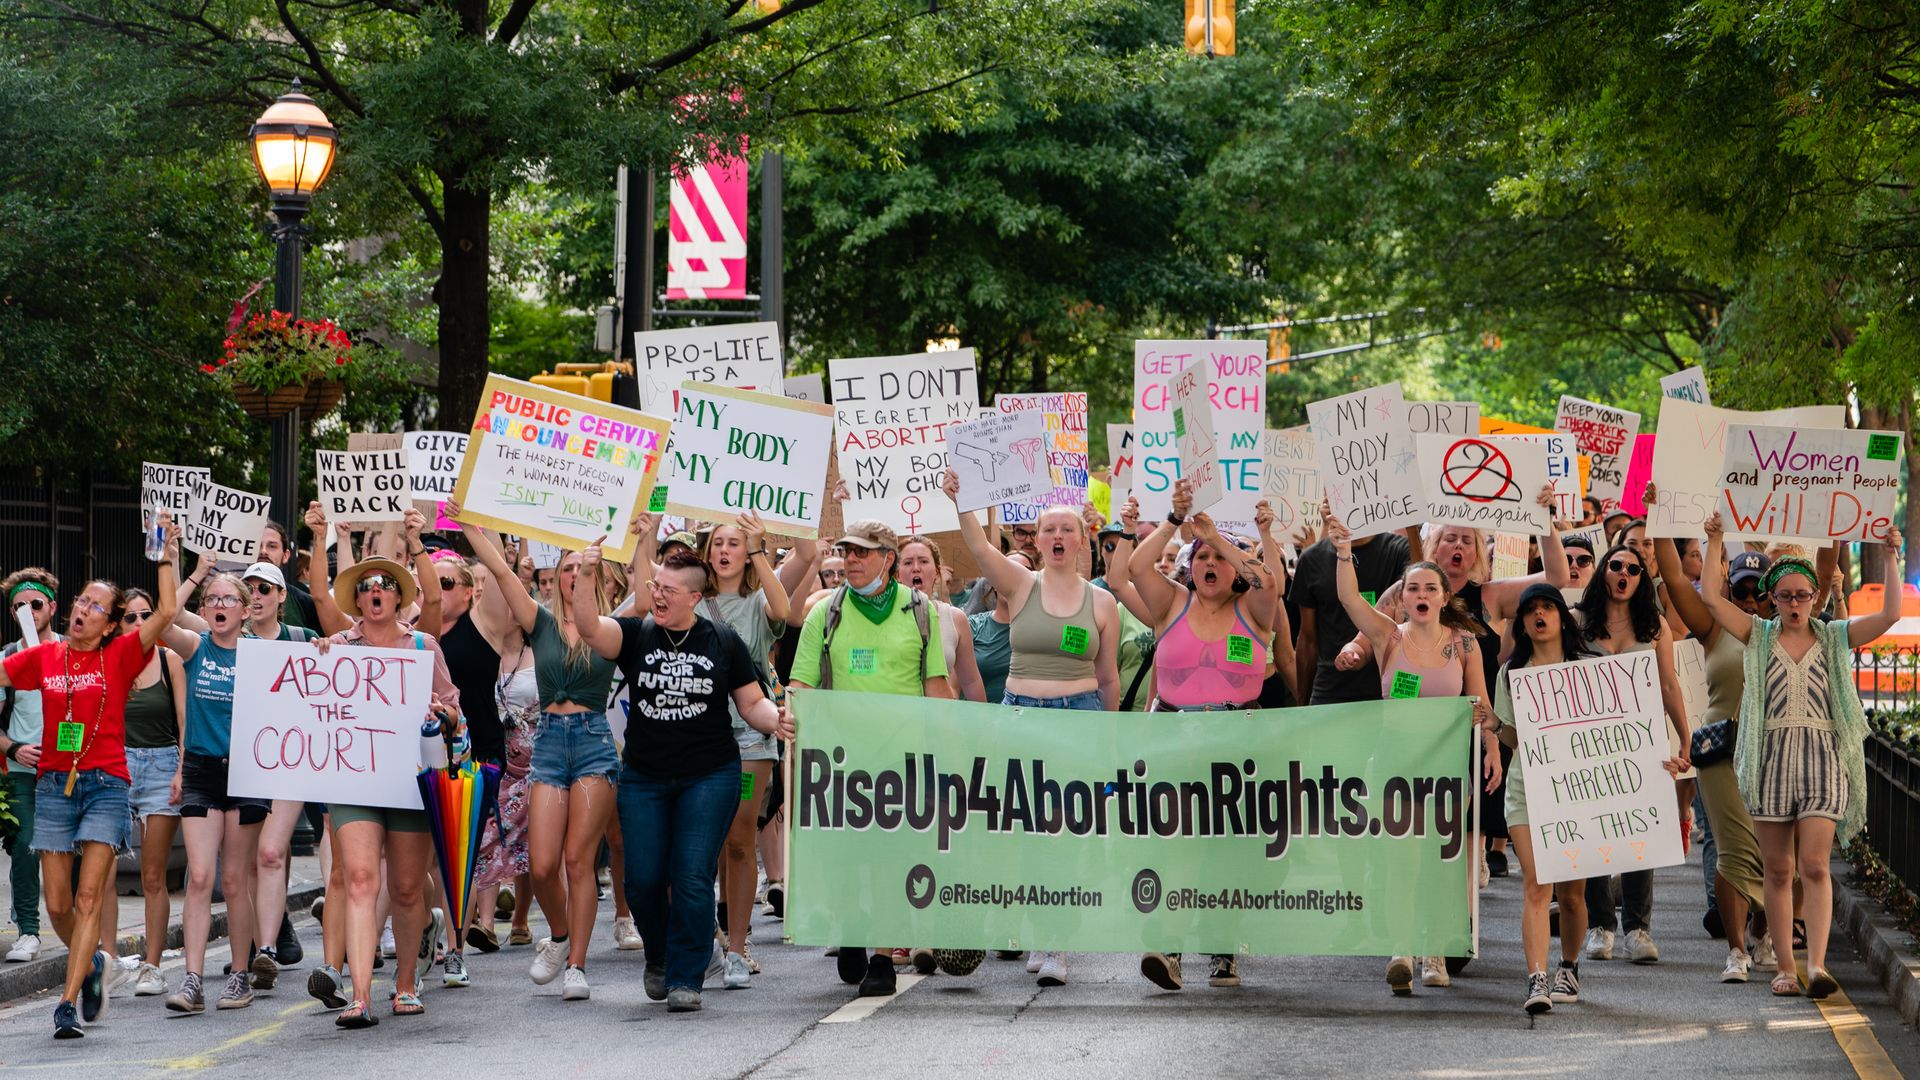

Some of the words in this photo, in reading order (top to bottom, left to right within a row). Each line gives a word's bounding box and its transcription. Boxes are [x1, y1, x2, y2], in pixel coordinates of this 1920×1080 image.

[645, 335, 774, 370] PRO-LIFE
[1143, 352, 1192, 375] GET
[1211, 352, 1262, 378] YOUR
[725, 365, 739, 381] A
[1176, 372, 1197, 400] HER
[835, 377, 866, 401] I
[490, 390, 572, 426] PUBLIC
[579, 415, 661, 451] CERVIX
[678, 397, 728, 431] MY
[838, 406, 931, 427] REGRET
[947, 401, 973, 417] MY
[955, 424, 977, 434] GUNS
[980, 418, 998, 428] HAVE
[1061, 412, 1087, 431] KILL
[1337, 396, 1367, 436] MY
[1563, 401, 1593, 416] KEEP
[1596, 408, 1625, 425] YOUR
[843, 420, 962, 452] ABORTI
[996, 424, 1012, 433] THAN
[1231, 430, 1259, 450] MY
[1559, 416, 1629, 440] THEOCRATIC
[416, 434, 467, 453] GIVE
[474, 413, 658, 474] ANNOUNCEMENT
[727, 426, 797, 466] BODY
[1332, 432, 1389, 476] BODY
[1575, 431, 1625, 455] ASCIST
[1749, 430, 1859, 472] Women
[319, 454, 345, 471] WE
[352, 452, 406, 471] WILL
[430, 456, 456, 471] US
[496, 444, 522, 460] THE
[525, 450, 575, 471] HARDEST
[578, 463, 625, 487] DECISION
[672, 451, 719, 485] MY
[856, 456, 888, 477] MY
[1145, 456, 1262, 492] STTE
[323, 475, 363, 492] NOT
[374, 473, 404, 491] GO
[506, 465, 515, 476] A
[524, 468, 570, 488] WOMAN
[572, 479, 605, 497] MAKES
[857, 478, 890, 499] MY
[1016, 484, 1031, 494] 2022
[1351, 469, 1379, 504] MY
[1589, 466, 1622, 487] ODIES
[1727, 469, 1758, 486] and
[1773, 472, 1843, 491] pregnant
[191, 478, 212, 502] MY
[214, 489, 269, 517] BODY
[334, 495, 403, 514] BACK
[499, 481, 555, 506] ISN'T
[561, 496, 618, 531] YOURS!
[723, 479, 814, 521] CHOICE
[200, 506, 228, 530] MY
[1346, 495, 1418, 531] CHOICE
[1474, 506, 1544, 529] again
[1725, 489, 1804, 534] Will
[1828, 491, 1890, 540] Die
[186, 523, 256, 556] CHOICE
[645, 648, 669, 665] OUR
[668, 651, 714, 671] BODIES
[660, 662, 694, 677] OUR
[269, 655, 416, 706] ABORT
[637, 671, 714, 695] FUTURES
[310, 702, 359, 723] THE
[638, 699, 708, 721] ABORTIONS
[655, 694, 689, 708] OUR
[253, 726, 396, 773] COURT
[1524, 734, 1555, 767] WE
[1570, 718, 1655, 760] ALREADY
[1551, 758, 1642, 804] MARCHED
[799, 746, 1464, 862] RiseUp4AbortionRights.org
[1541, 821, 1584, 849] FOR
[1591, 806, 1660, 839] THIS!
[940, 884, 1102, 909] @RiseUp4Abortion
[1166, 888, 1363, 915] @Rise4AbortionRights
